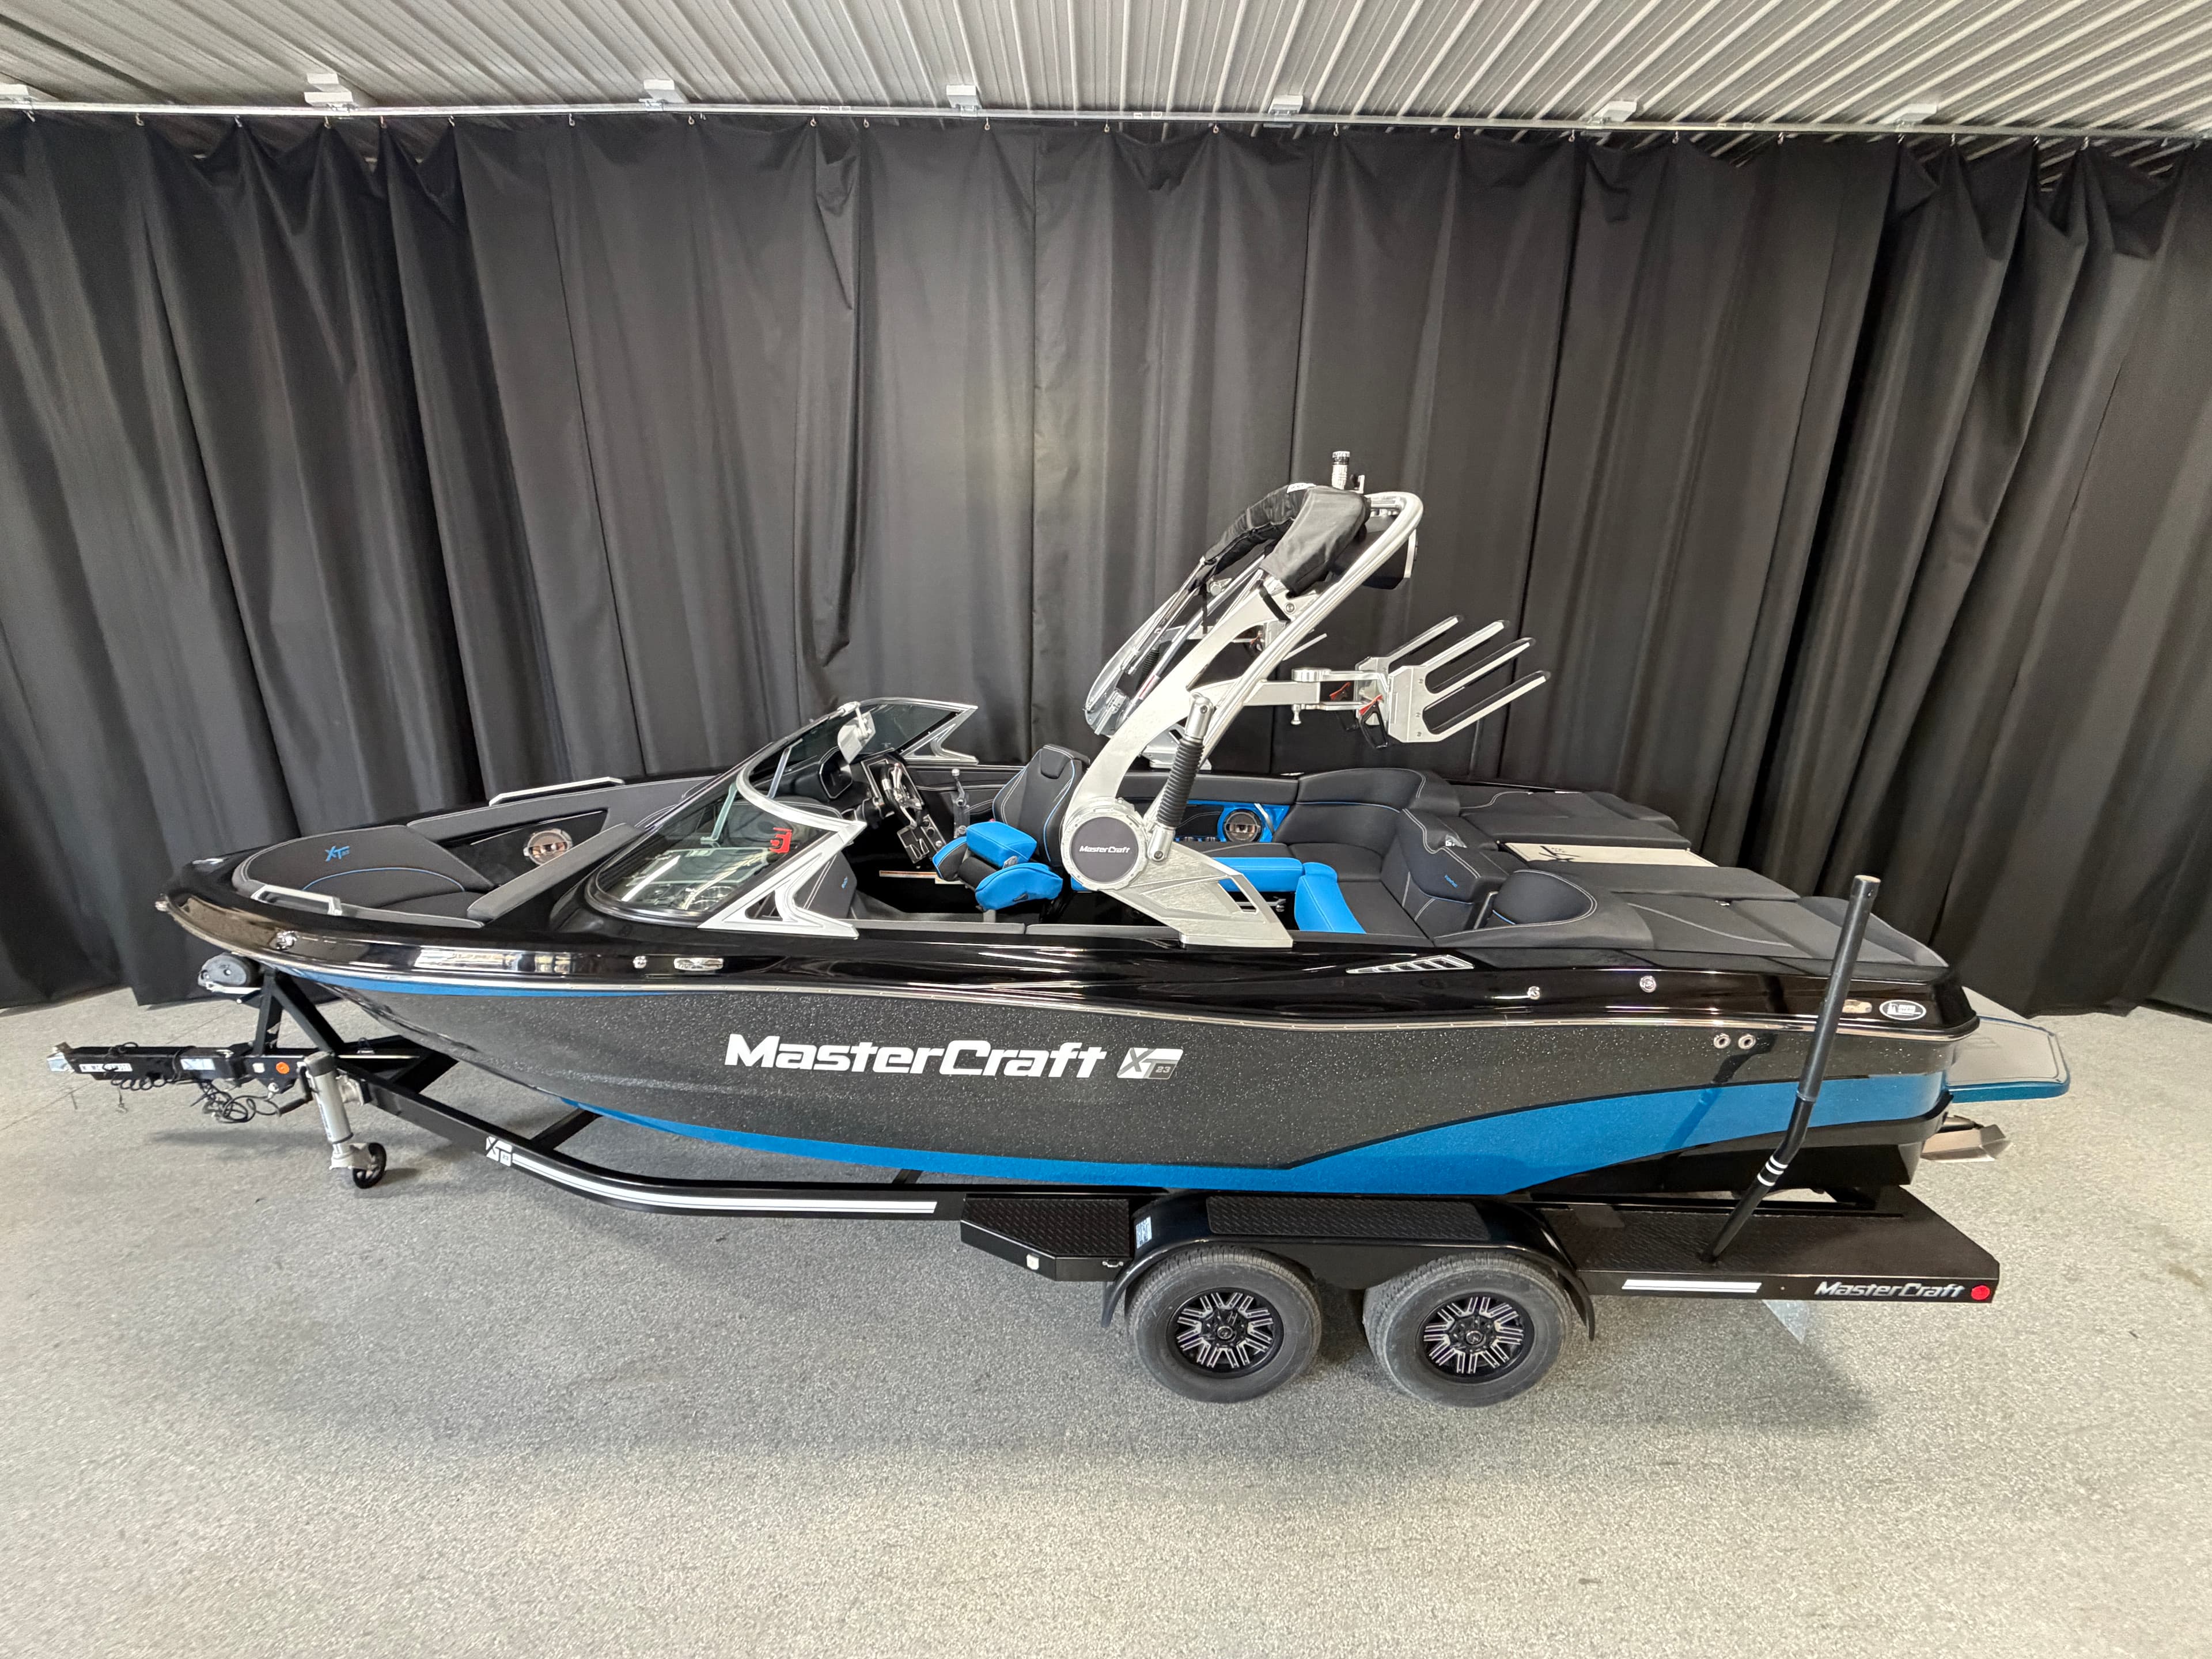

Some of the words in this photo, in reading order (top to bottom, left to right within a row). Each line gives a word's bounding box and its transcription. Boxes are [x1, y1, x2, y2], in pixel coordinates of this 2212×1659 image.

[1079, 845, 1131, 853] MasterCraft
[724, 1033, 1108, 1077] MasterCraft
[1814, 1281, 1965, 1298] MasterCraft
